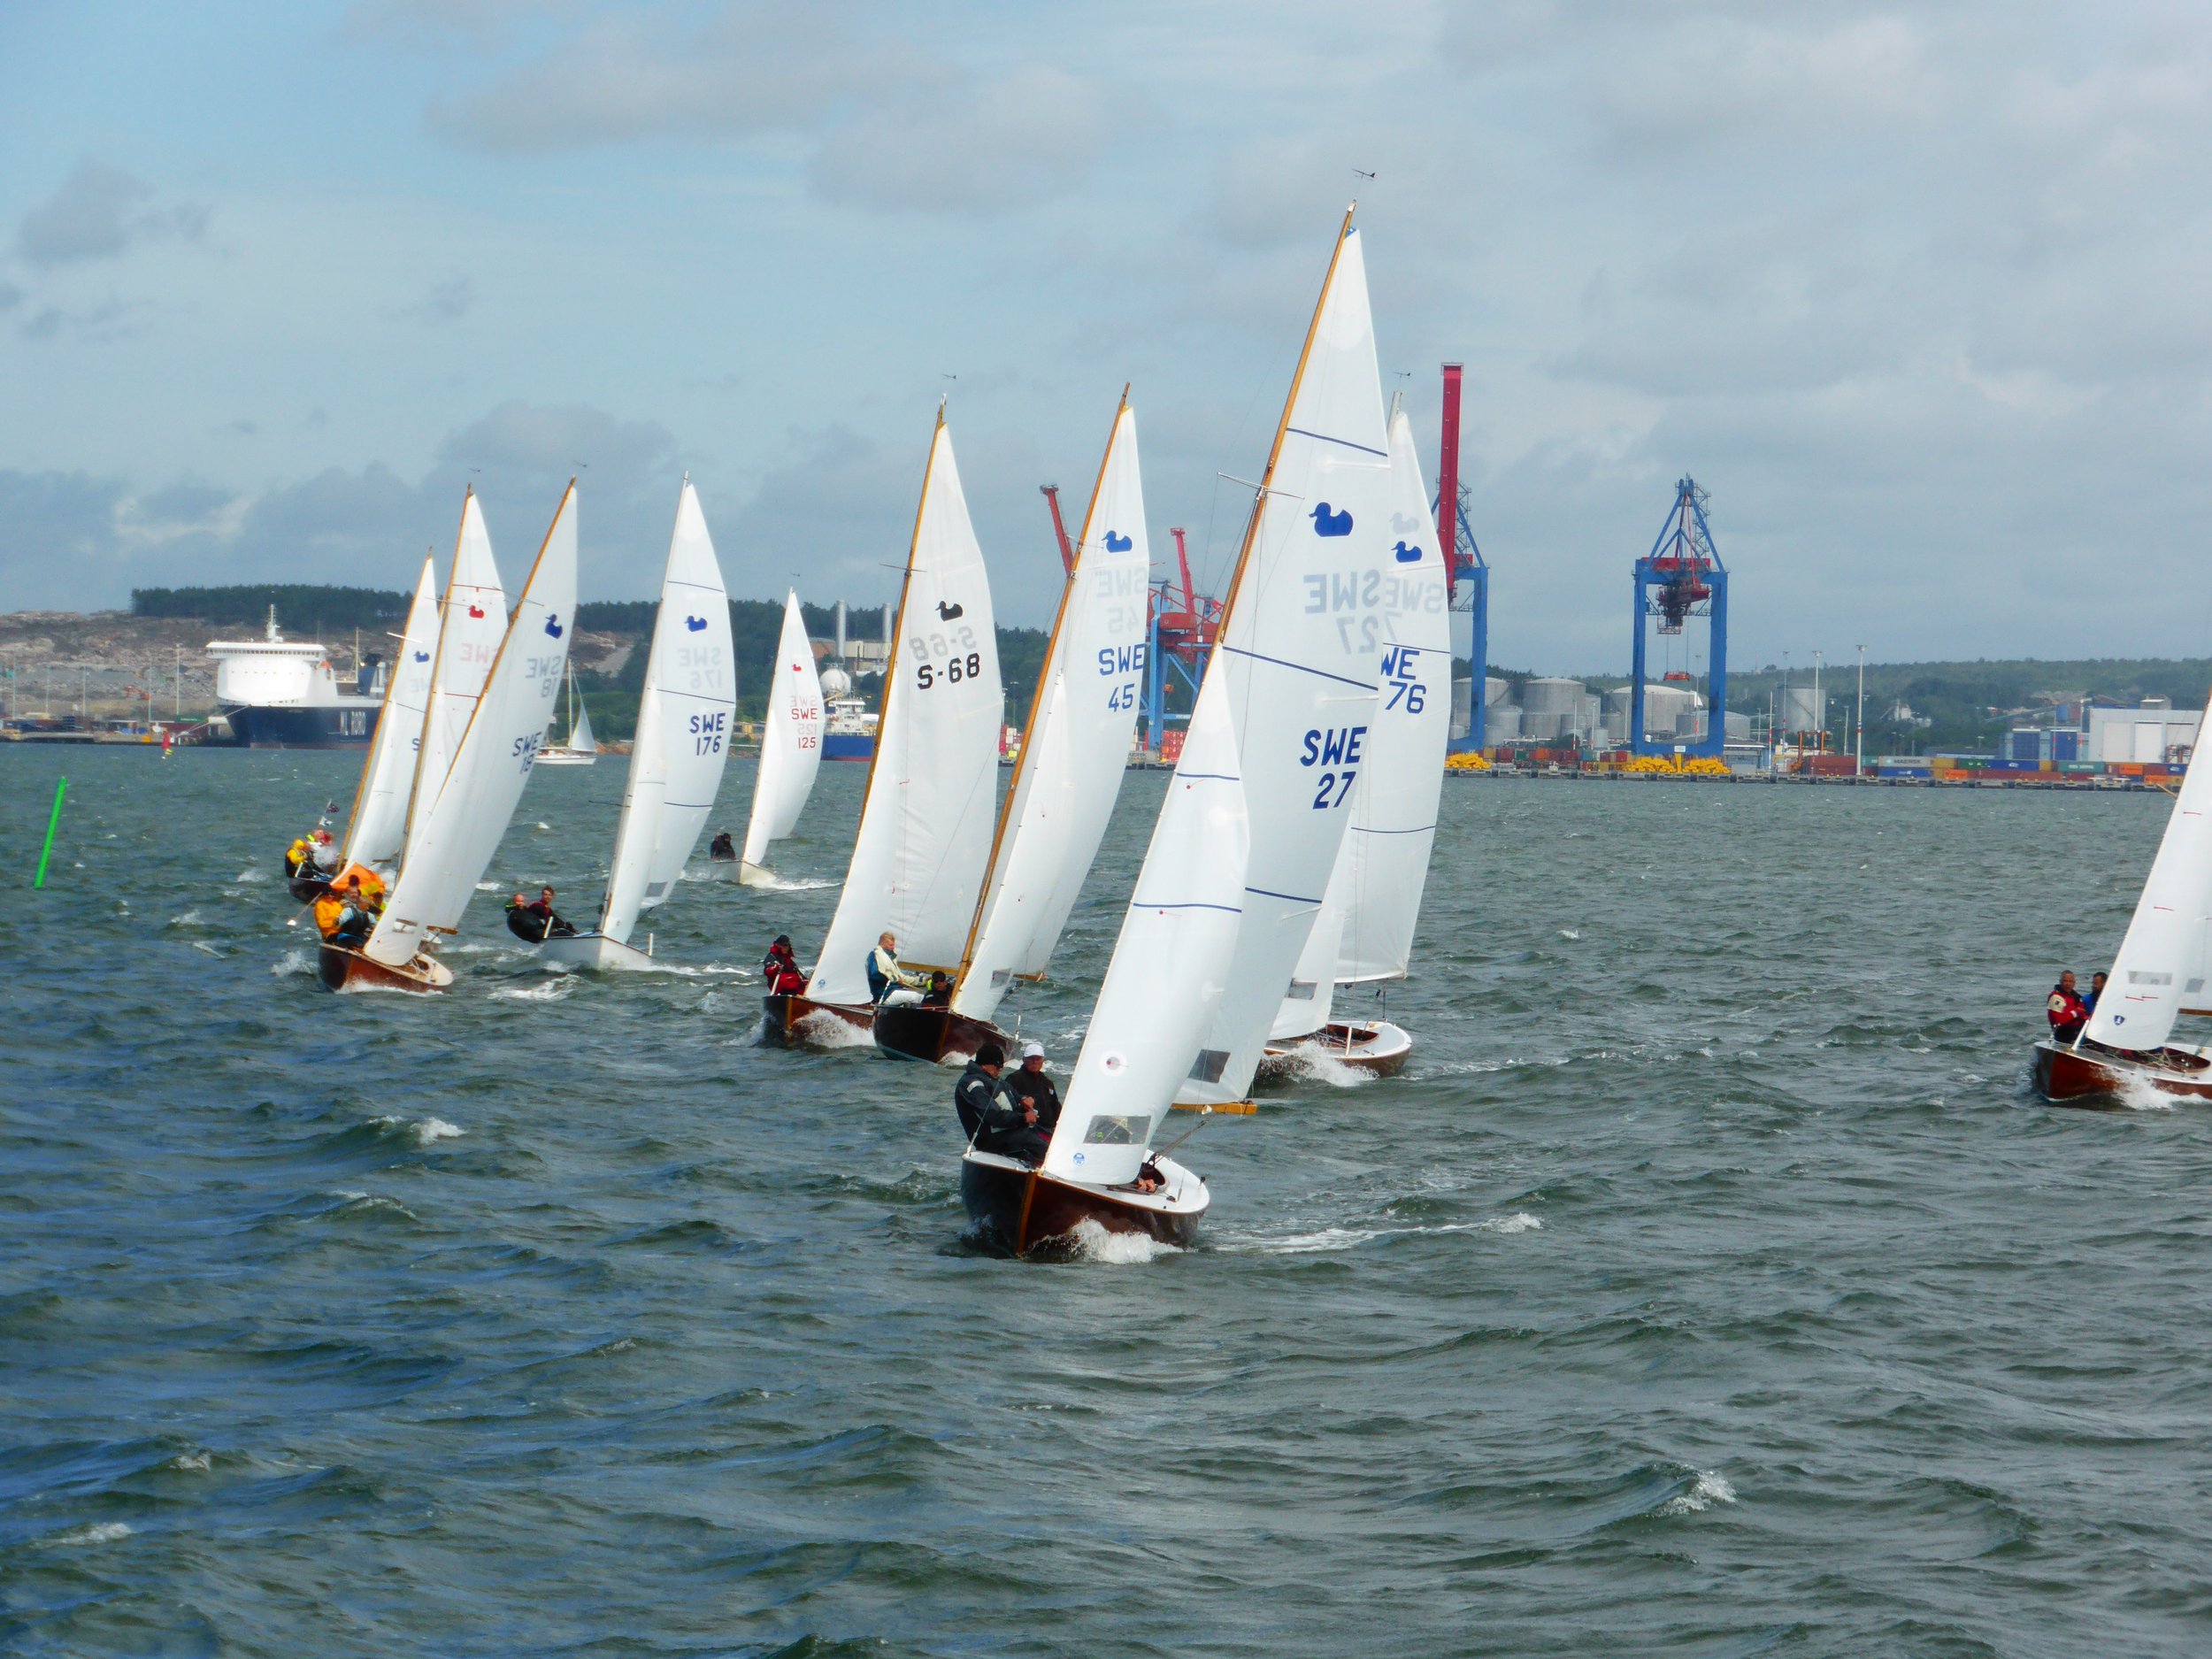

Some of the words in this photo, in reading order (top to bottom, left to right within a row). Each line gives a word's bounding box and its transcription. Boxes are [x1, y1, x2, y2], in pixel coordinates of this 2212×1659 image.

[918, 652, 979, 690] S-68
[1098, 643, 1145, 676] SWE
[1380, 647, 1420, 680] WE
[1108, 683, 1135, 712] 45
[1385, 680, 1426, 714] 76
[689, 712, 726, 733] SWE
[791, 708, 818, 720] SWE
[512, 731, 542, 757] SWE
[696, 735, 722, 756] 176
[798, 737, 816, 749] 125
[1300, 726, 1368, 767] SWE
[1312, 771, 1356, 810] 27
